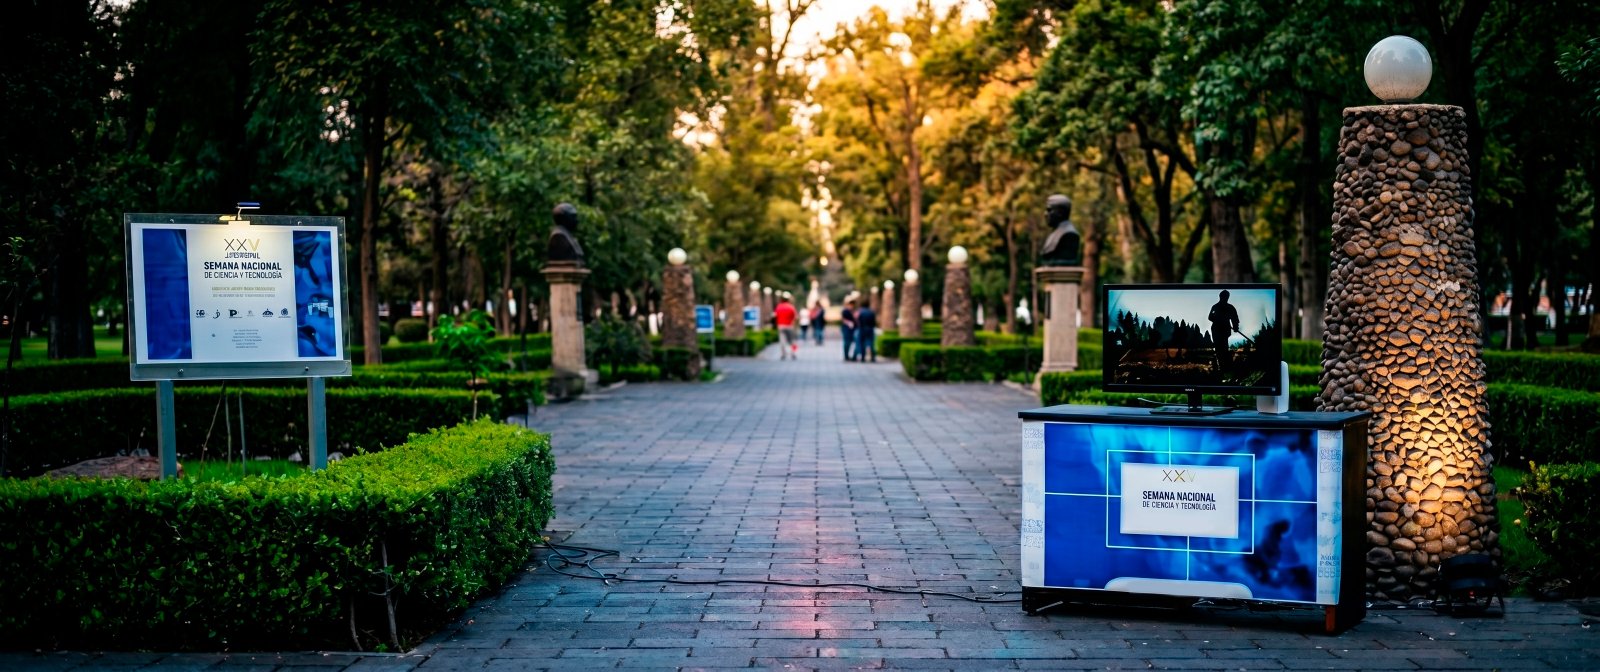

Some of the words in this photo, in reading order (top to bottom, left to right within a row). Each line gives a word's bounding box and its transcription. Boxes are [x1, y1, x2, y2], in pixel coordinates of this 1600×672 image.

[224, 238, 260, 251] XXV
[204, 262, 239, 270] SEMANA
[242, 262, 282, 270] NACIONAL
[1162, 469, 1196, 482] XXV
[1142, 491, 1175, 500] SEMANA
[1177, 492, 1216, 502] NACIONAL
